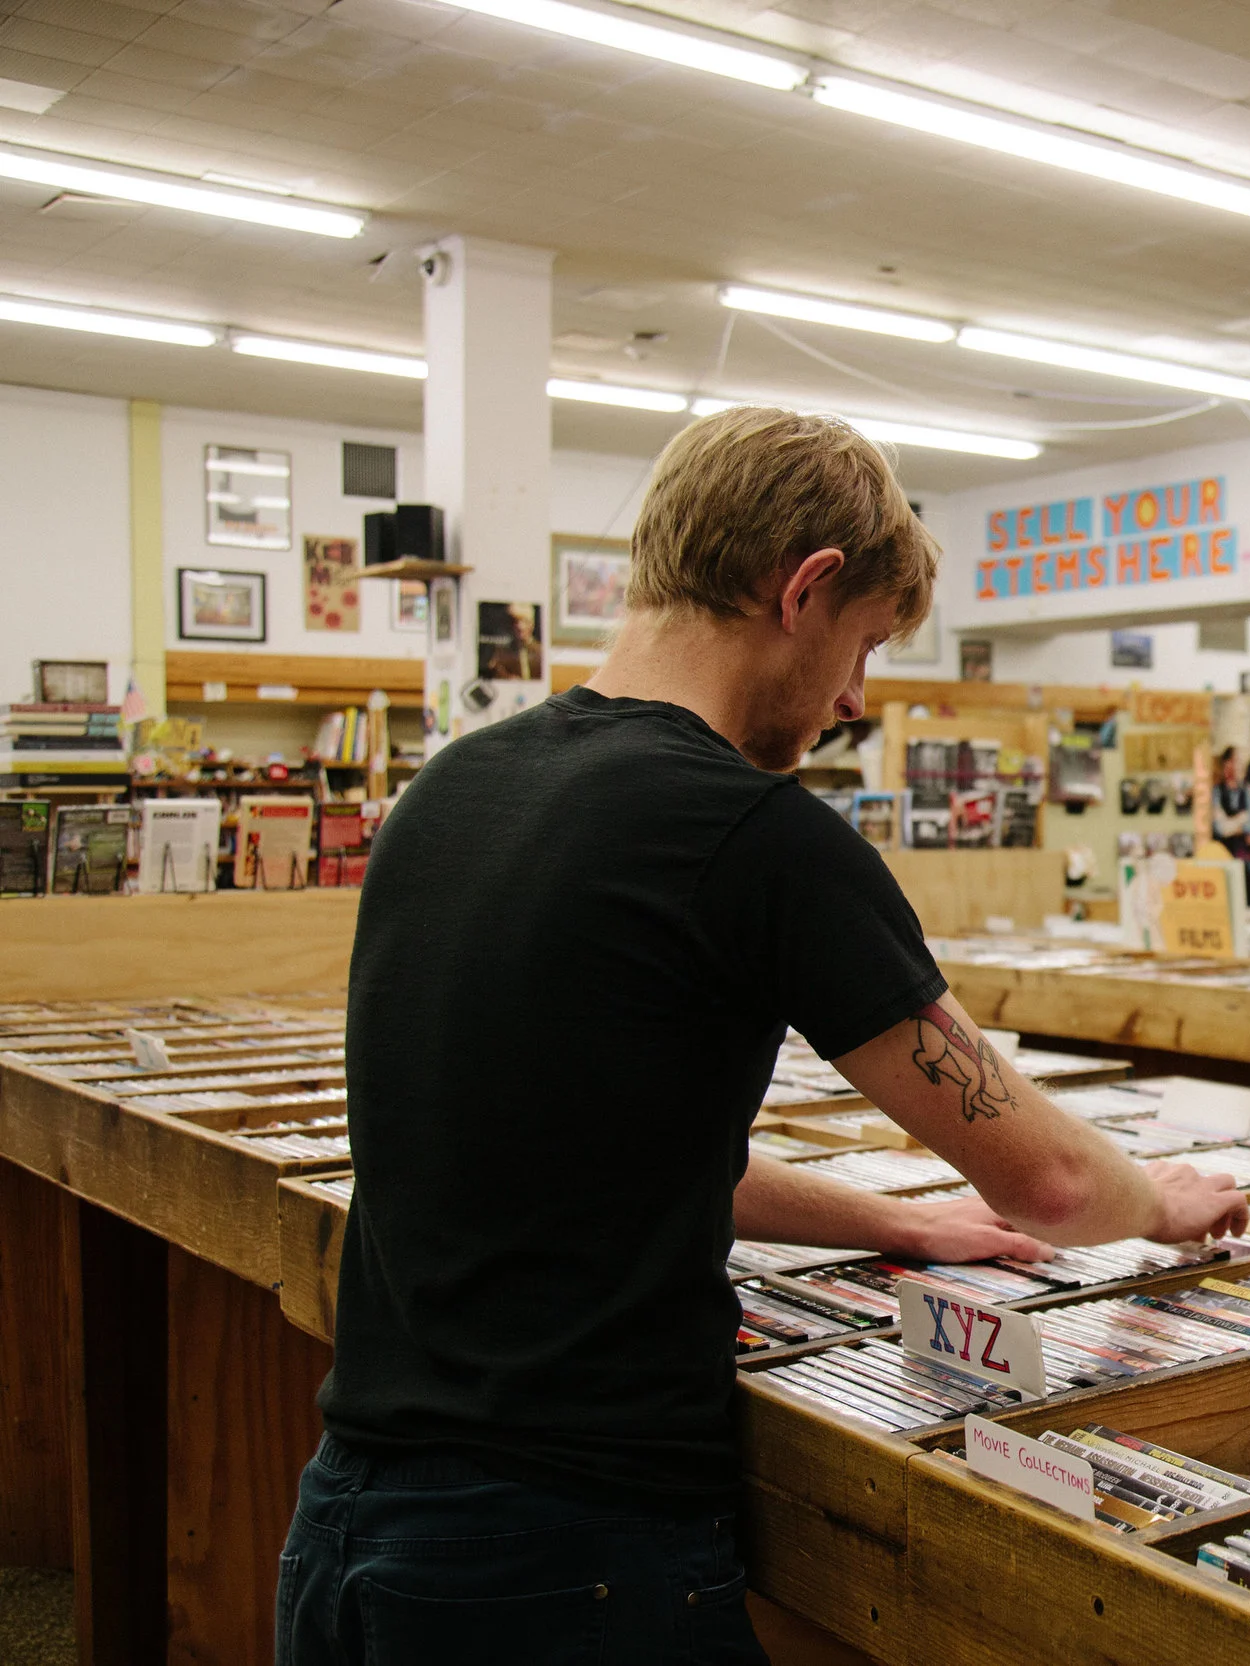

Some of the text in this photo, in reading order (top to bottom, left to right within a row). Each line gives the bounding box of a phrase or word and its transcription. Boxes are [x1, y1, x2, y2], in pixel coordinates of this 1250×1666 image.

[988, 479, 1220, 552] SELL YOUR
[976, 530, 1232, 600] ITEMS HERE
[1173, 880, 1217, 899] DVD
[923, 1294, 1011, 1374] XYZ
[973, 1428, 1092, 1496] MOVIE COLLECTIONS
[1125, 1455, 1161, 1473] MICHAEL
